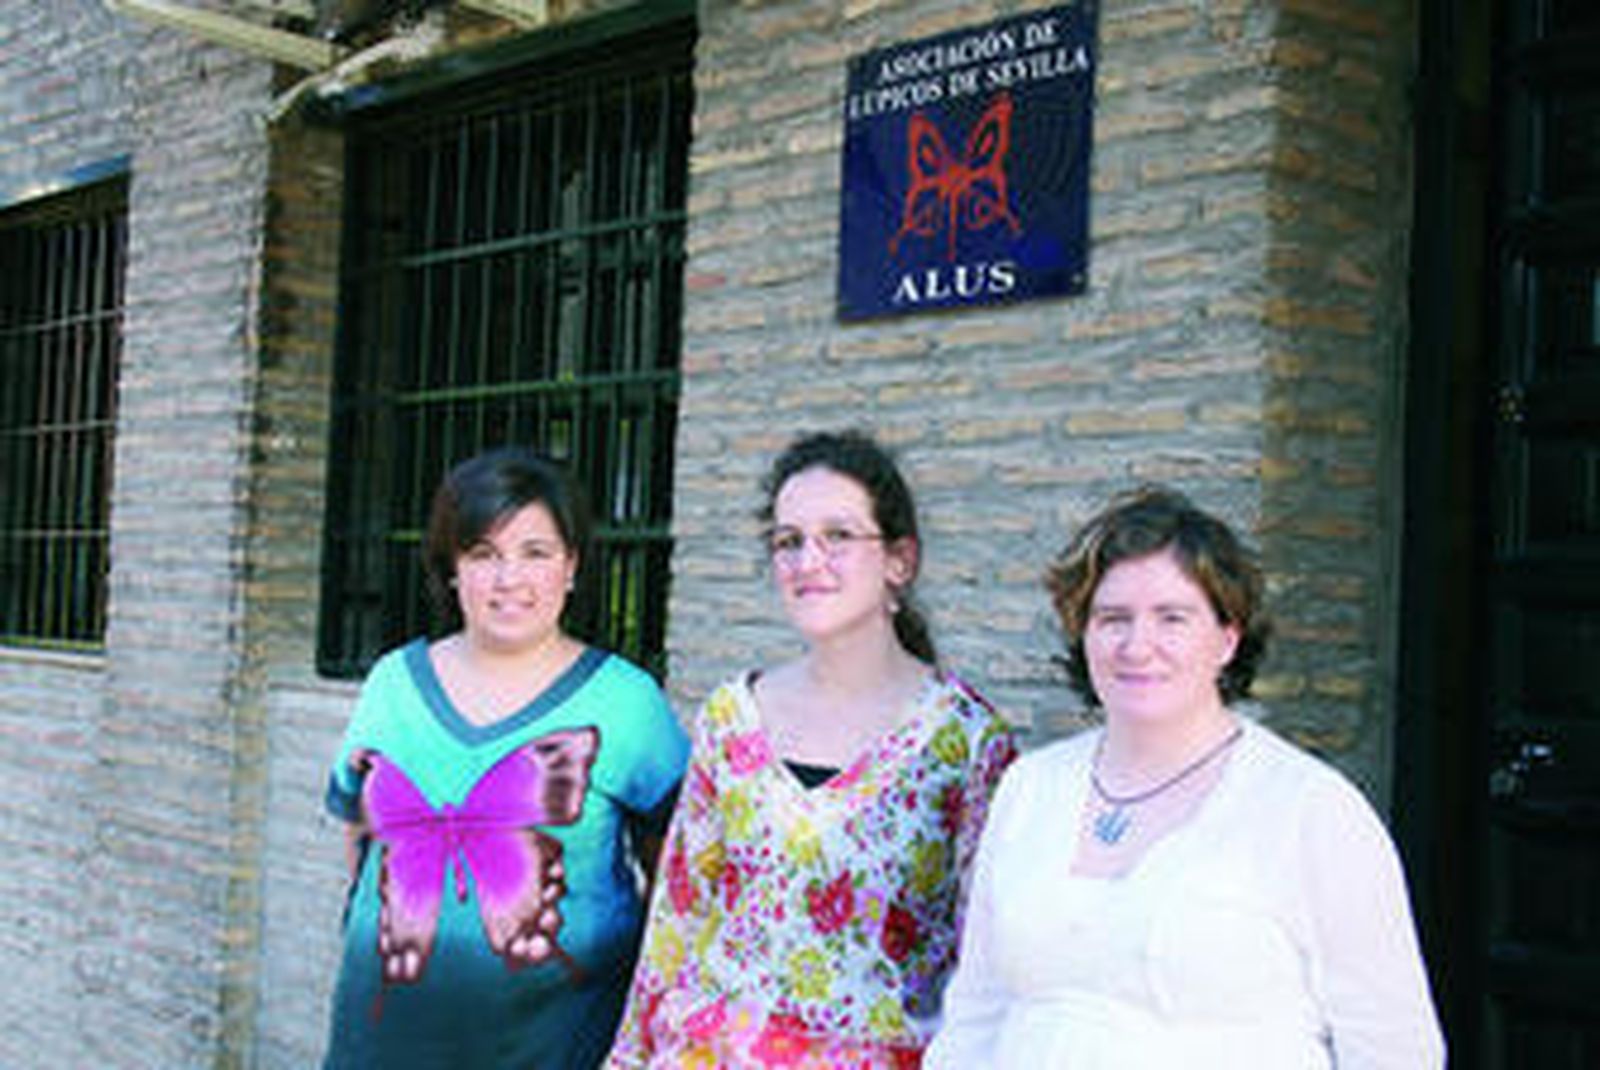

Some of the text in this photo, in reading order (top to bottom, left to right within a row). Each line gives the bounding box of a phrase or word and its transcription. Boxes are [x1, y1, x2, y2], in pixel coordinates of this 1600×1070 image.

[1024, 18, 1058, 48] DE
[949, 70, 979, 96] DE
[983, 46, 1089, 86] SEVILLA
[892, 261, 1016, 303] ALUS
